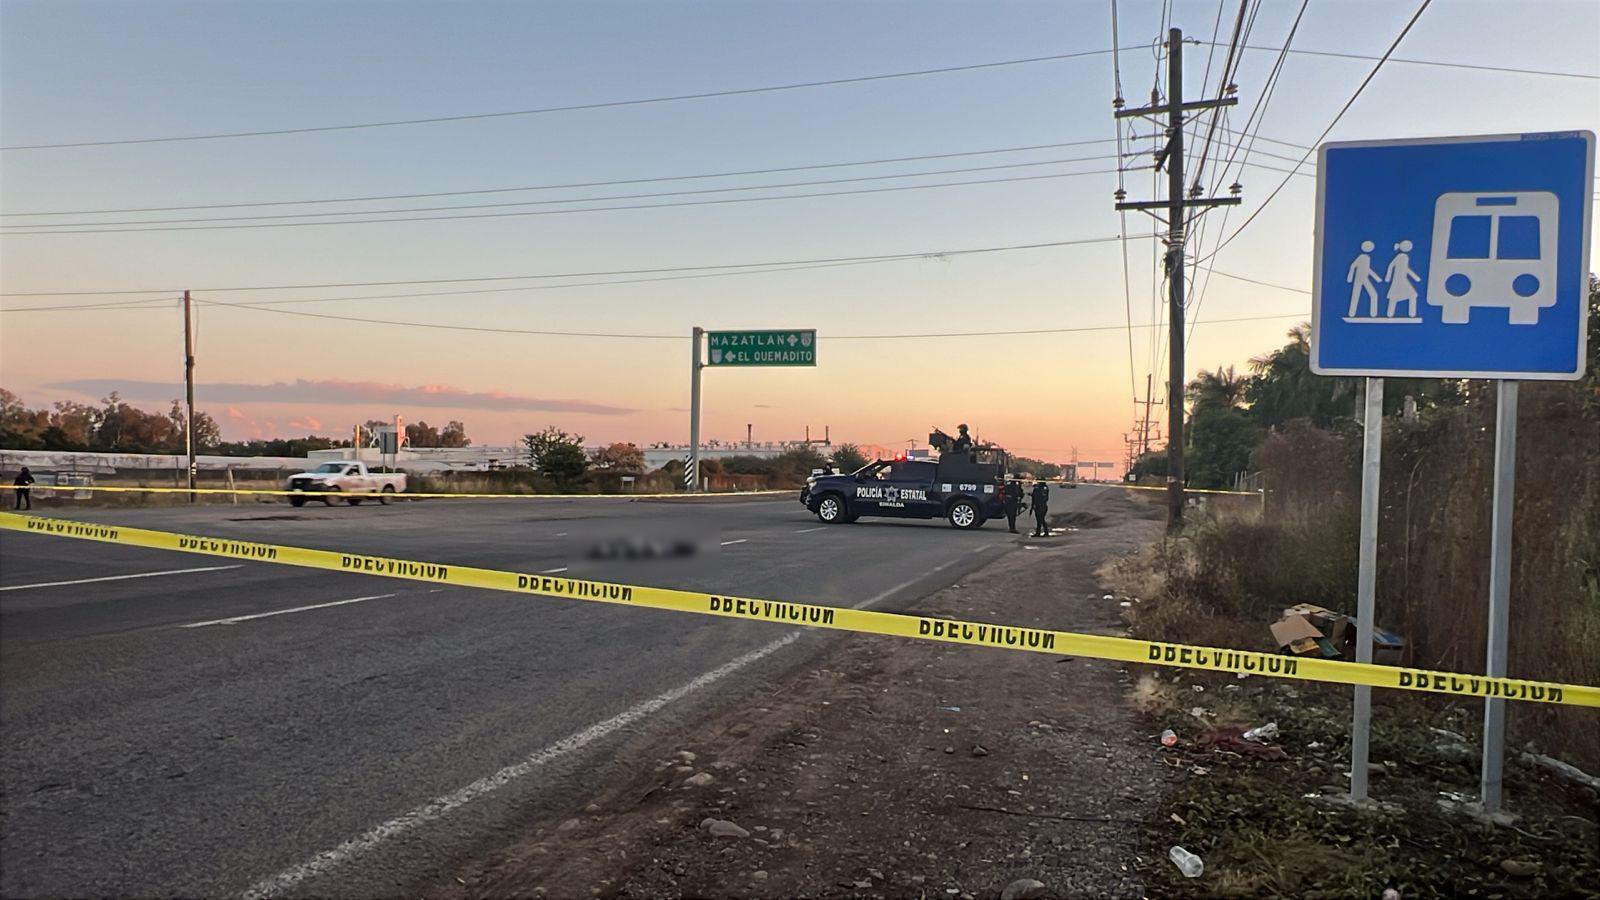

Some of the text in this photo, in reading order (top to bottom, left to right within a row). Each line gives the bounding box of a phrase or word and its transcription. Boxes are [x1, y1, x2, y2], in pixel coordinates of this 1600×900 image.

[711, 335, 784, 346] MAZATLAN
[738, 351, 812, 361] EL QUEMADITO
[856, 486, 927, 500] POLICÍA ESTATAL
